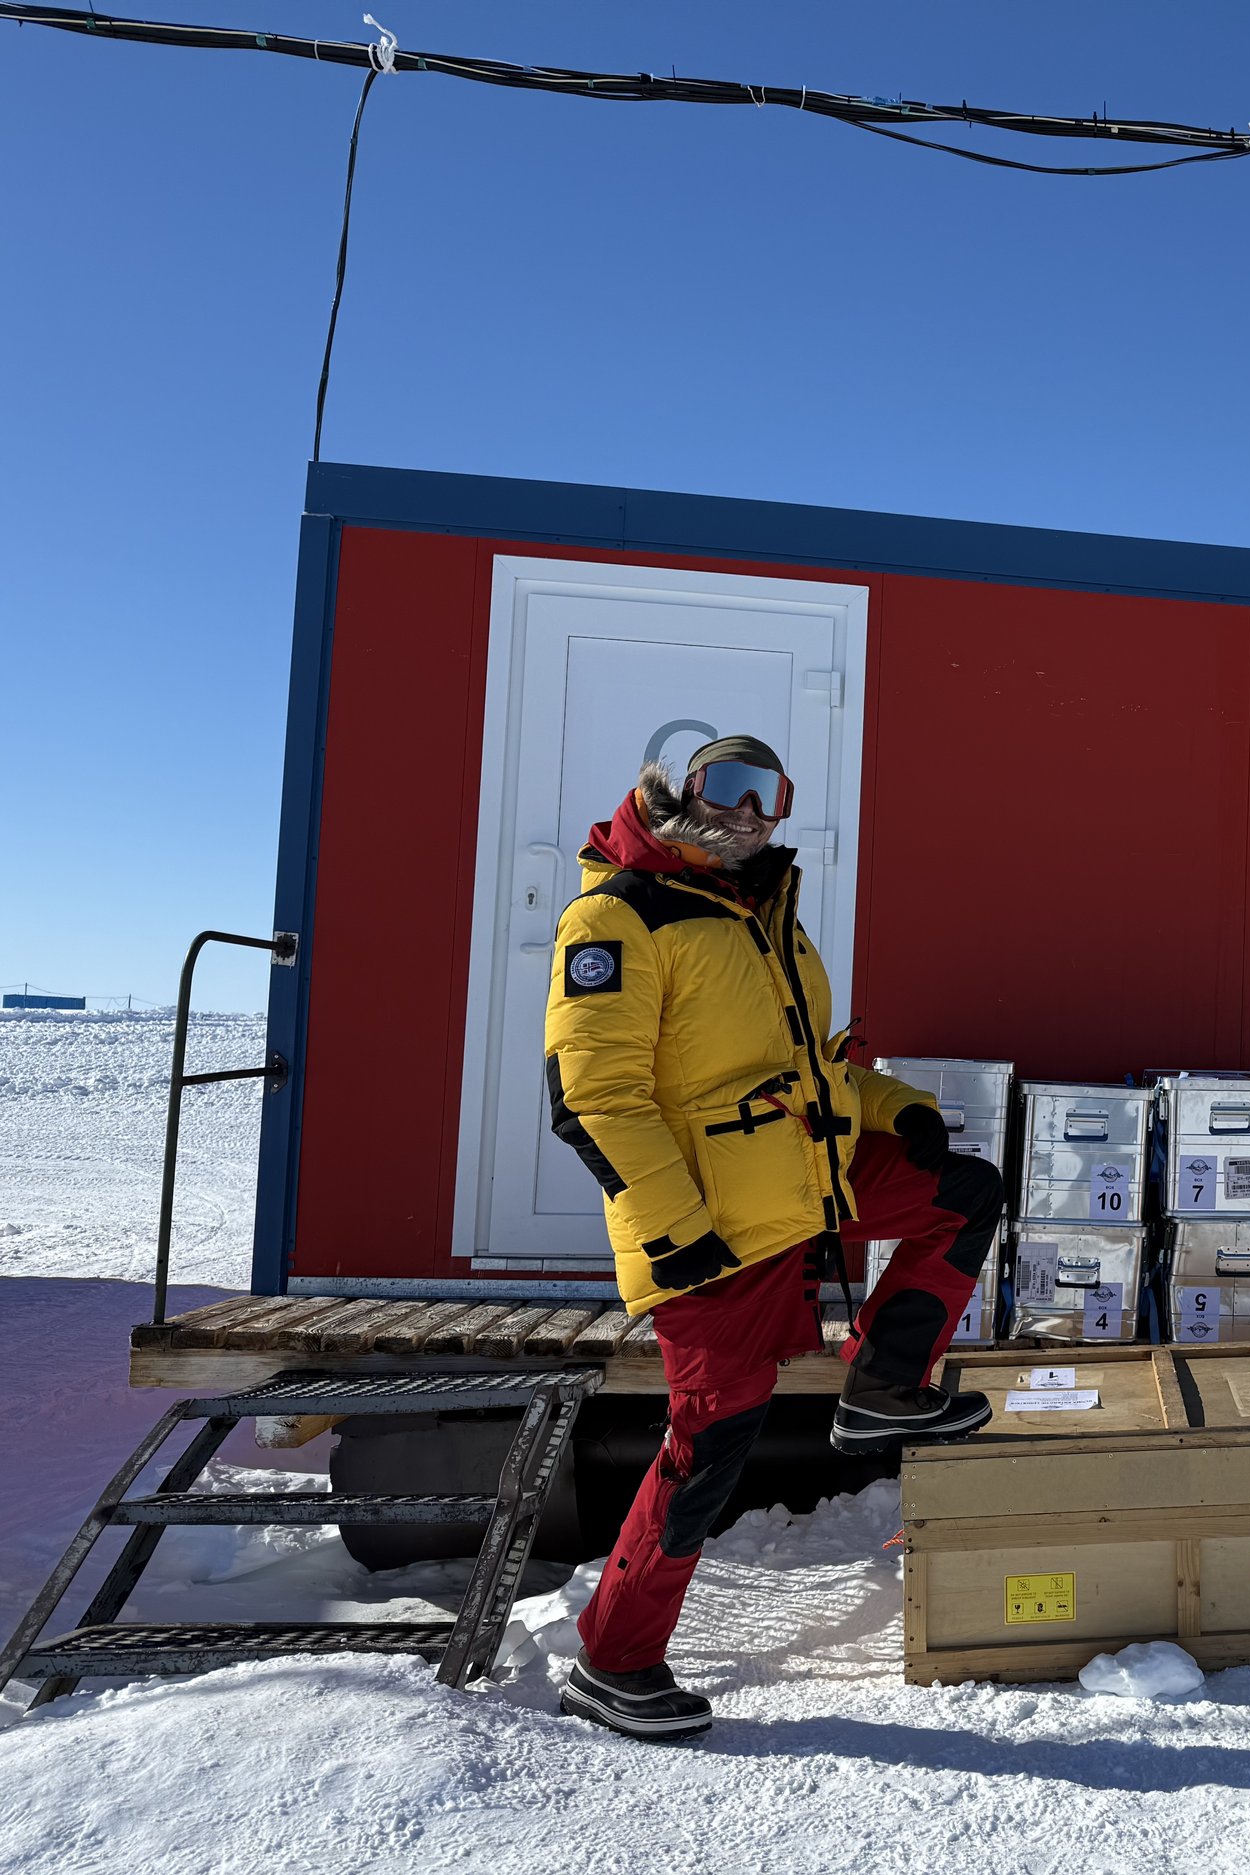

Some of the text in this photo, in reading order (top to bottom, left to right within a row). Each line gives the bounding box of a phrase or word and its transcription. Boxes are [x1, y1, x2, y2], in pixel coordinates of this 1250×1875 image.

[1097, 1192, 1121, 1211] 10
[1192, 1185, 1204, 1202] 7
[1195, 1293, 1207, 1311] 5
[1095, 1312, 1108, 1330] 4
